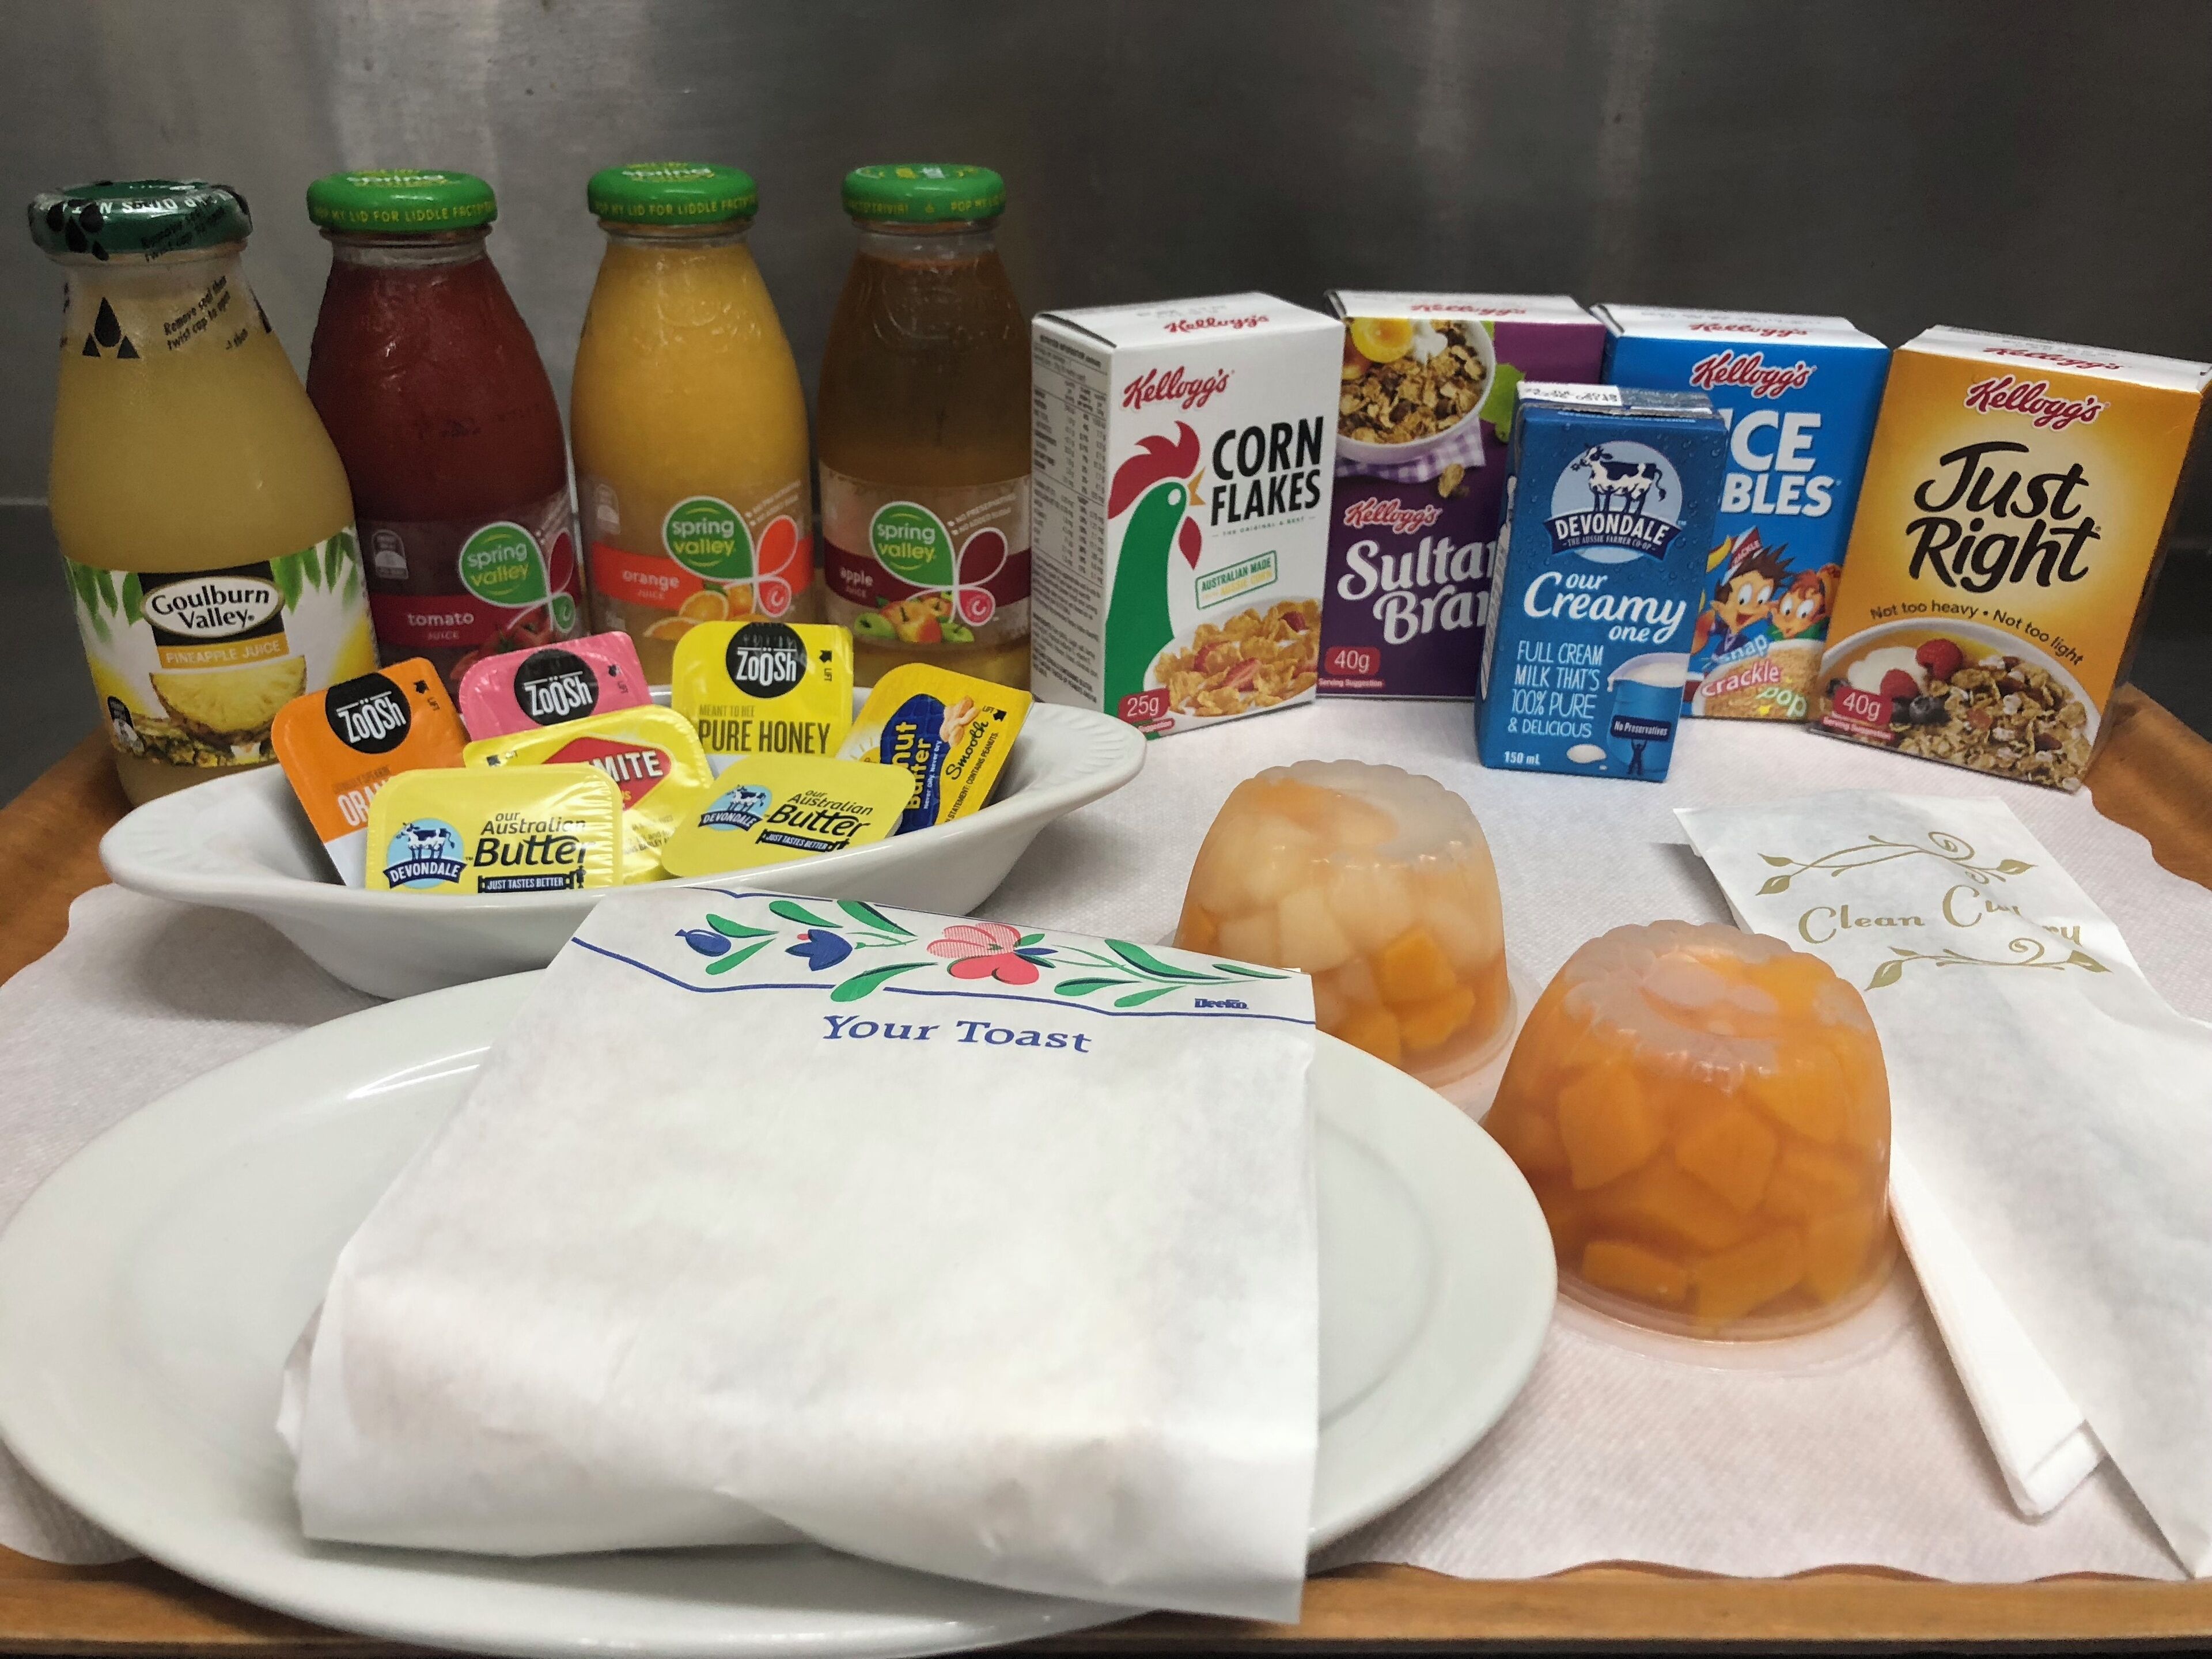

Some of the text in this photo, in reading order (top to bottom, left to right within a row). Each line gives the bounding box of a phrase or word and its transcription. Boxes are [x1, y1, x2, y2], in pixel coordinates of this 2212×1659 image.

[1983, 347, 2121, 369] Kellogg's
[1691, 351, 1810, 397] Kellogg's
[1122, 366, 1230, 410] Kellogg's
[1965, 376, 2101, 430] Kellogg's
[1212, 416, 1324, 480] CORN
[1914, 441, 2089, 521] Just
[1210, 469, 1321, 527] FLAKES
[1344, 497, 1438, 534] Kellogg's
[672, 517, 734, 539] spring
[876, 522, 935, 544] spring
[1555, 513, 1669, 546] DEVONDALE
[673, 538, 735, 556] valley
[878, 541, 936, 563] valley
[1567, 535, 1652, 551] THE AUSSIE FARMER CO-OP
[1906, 516, 2101, 593] Right
[467, 543, 527, 569] spring
[471, 562, 529, 586] valley
[623, 570, 679, 592] orange
[840, 567, 873, 587] apple
[1202, 557, 1271, 592] AUSTRALIAN MADE
[1566, 574, 1607, 590] our
[151, 585, 270, 616] Goulburn
[1523, 571, 1687, 644] Creamy
[178, 608, 250, 630] Valley
[408, 612, 474, 626] tomato
[1608, 624, 1649, 643] one
[1870, 600, 2084, 666] Not too heavy Not too light
[166, 641, 281, 664] PINEAPPLE JUICE
[1335, 650, 1370, 674] 40g
[1517, 640, 1604, 666] FULL CREAM
[824, 668, 832, 681] LIFT
[1514, 664, 1600, 692] MILK THAT'S
[699, 704, 726, 717] MEANT
[730, 705, 740, 717] TO
[1127, 695, 1159, 717] 25g
[1512, 688, 1597, 719] 100% PURE
[1843, 692, 1881, 722] 40g
[699, 719, 831, 754] PURE HONEY
[1508, 717, 1592, 738] & DELICIOUS
[1614, 721, 1668, 736] No Preservatives
[930, 753, 938, 772] Never
[934, 740, 942, 752] Dry
[945, 721, 988, 780] Smooth
[1505, 751, 1524, 764] 150
[966, 757, 985, 785] CONTAINS
[788, 793, 873, 816] Australian
[805, 790, 827, 798] our
[481, 816, 586, 835] Australian
[495, 812, 520, 822] our
[703, 811, 757, 826] DEVONDALE
[767, 804, 870, 837] Butter
[474, 835, 596, 867] Butter
[766, 834, 828, 850] JUST TASTES BETTER
[391, 862, 461, 882] DEVONDALE
[487, 877, 563, 890] JUST TASTES BETTER
[1798, 904, 1926, 944] Clean
[823, 1015, 1093, 1053] Your Toast
